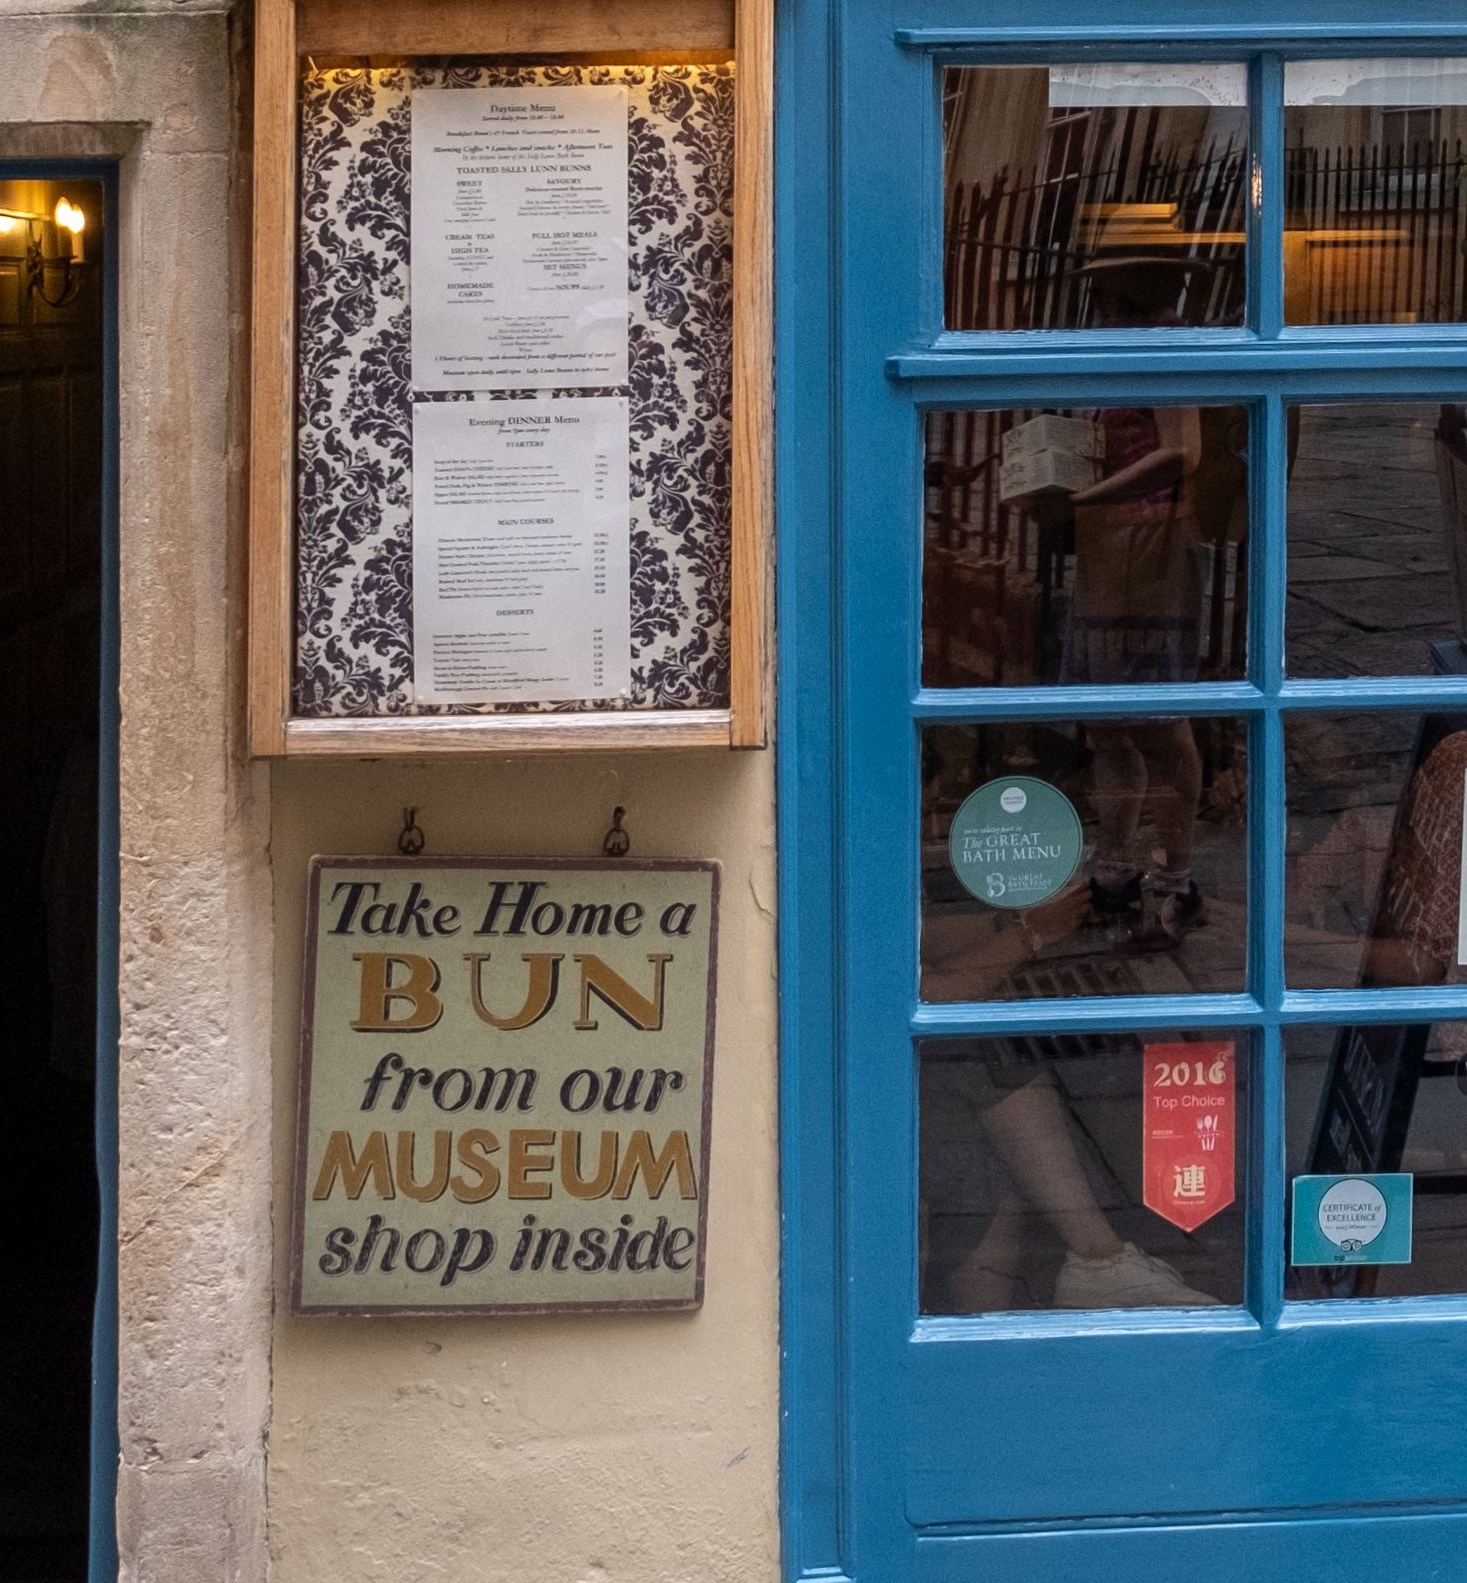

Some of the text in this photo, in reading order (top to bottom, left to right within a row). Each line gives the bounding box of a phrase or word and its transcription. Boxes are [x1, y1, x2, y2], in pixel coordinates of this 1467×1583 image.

[489, 103, 557, 114] Daytime Menu
[456, 166, 499, 175] TOASTED
[469, 415, 581, 428] Evening DINNER Menu
[962, 832, 1042, 850] The GREAT
[962, 845, 1062, 864] BATH MENU
[327, 880, 698, 939] Take Home a
[349, 951, 675, 1033] BUN
[359, 1052, 687, 1114] from our
[1153, 1094, 1226, 1110] Top Choice
[312, 1128, 698, 1204] MUSEUM
[1322, 1203, 1374, 1213] CERTIFICATE
[1326, 1213, 1377, 1223] EXCELLENCE
[318, 1213, 697, 1287] shop inside
